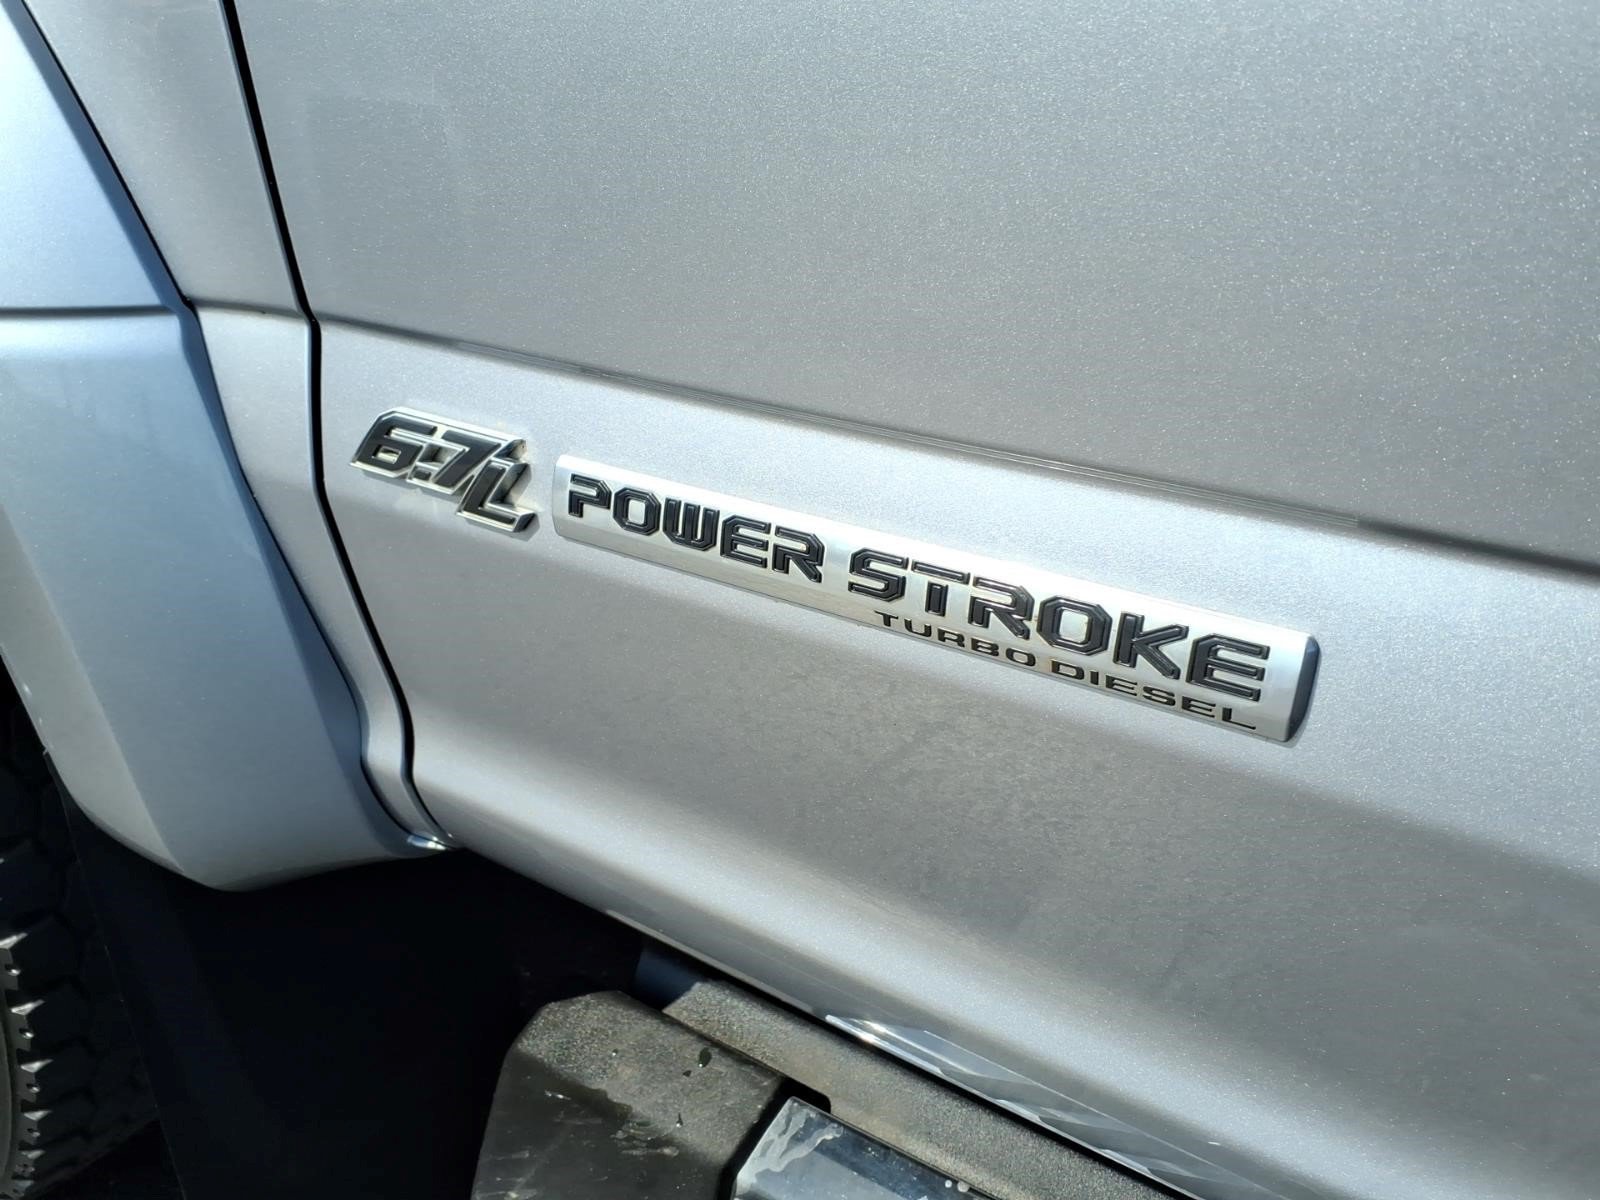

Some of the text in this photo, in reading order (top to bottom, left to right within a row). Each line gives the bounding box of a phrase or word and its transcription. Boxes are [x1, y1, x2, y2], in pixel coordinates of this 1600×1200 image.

[351, 407, 538, 533] 6.7L
[568, 473, 1270, 701] POWER STROKE
[874, 610, 1256, 730] TURBO DIESEL
